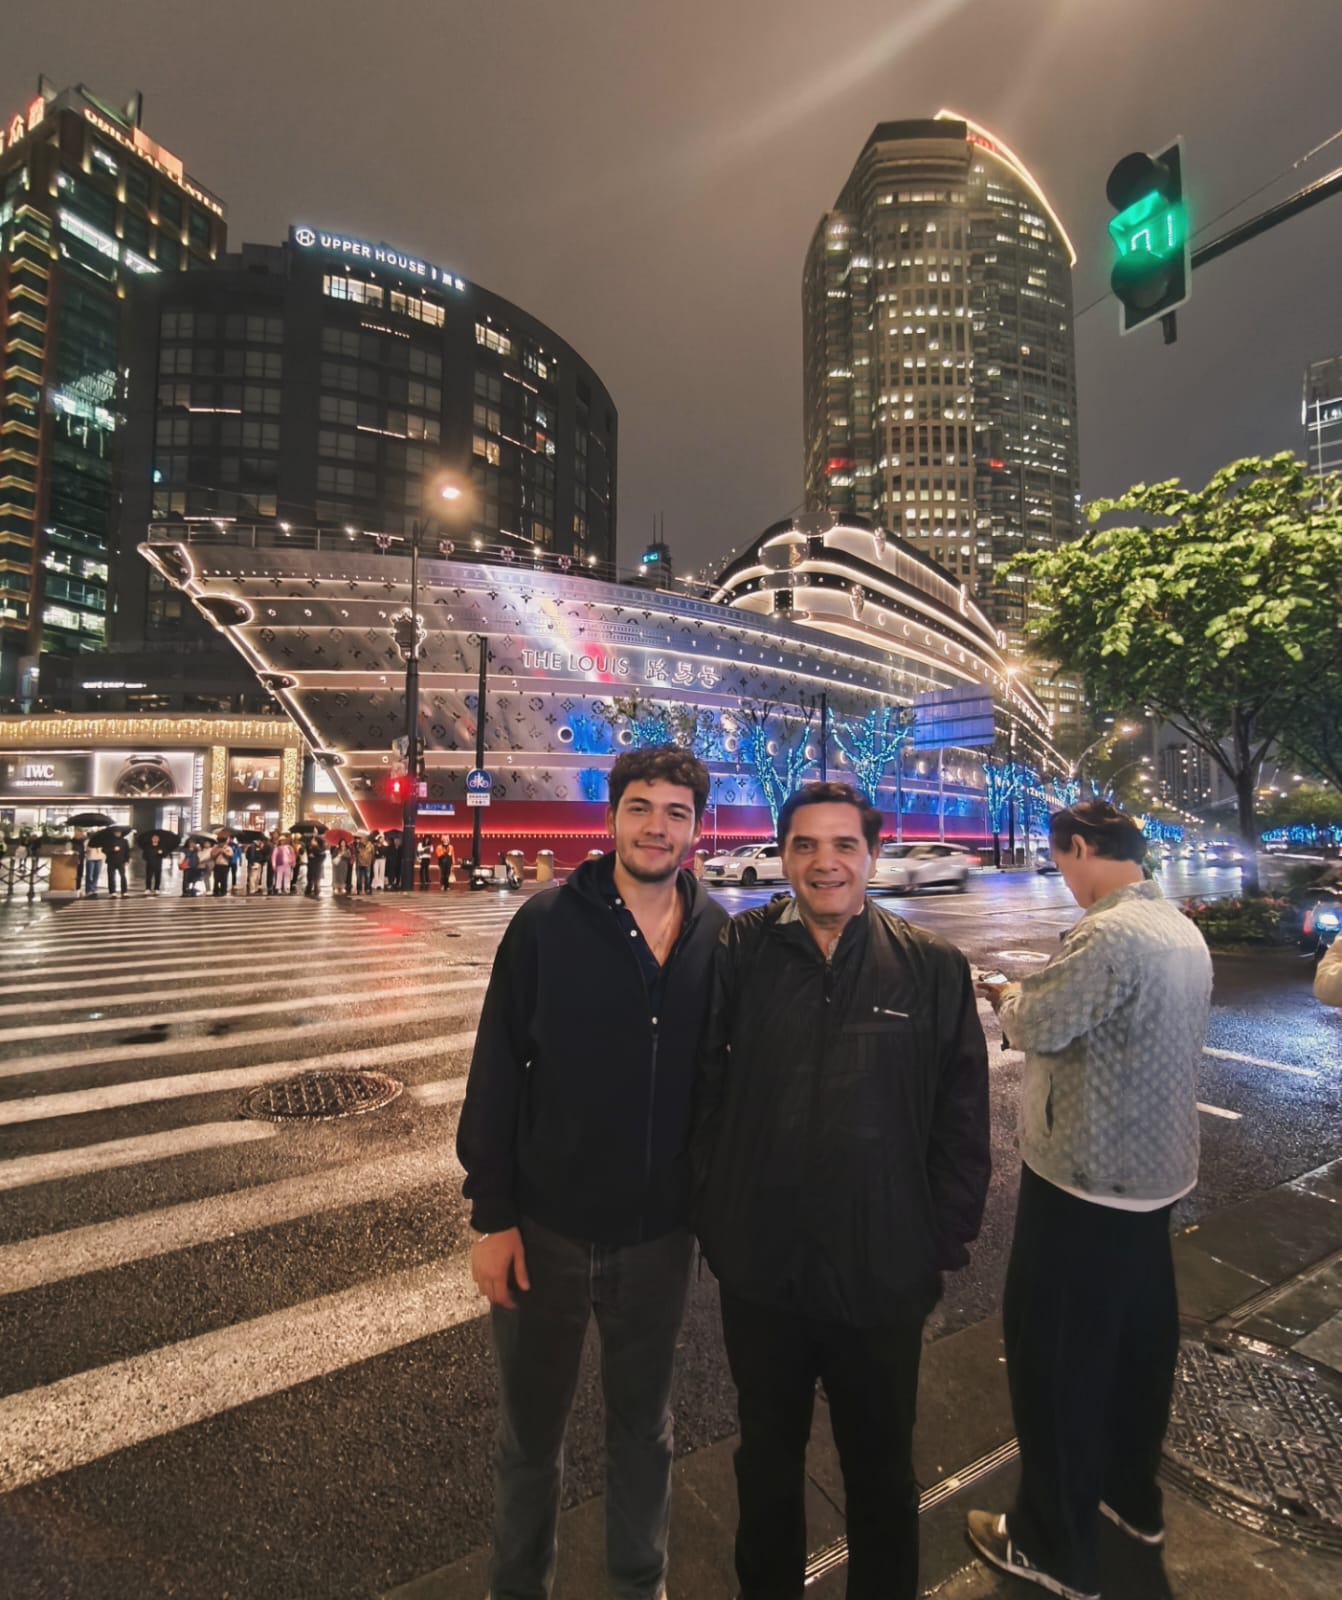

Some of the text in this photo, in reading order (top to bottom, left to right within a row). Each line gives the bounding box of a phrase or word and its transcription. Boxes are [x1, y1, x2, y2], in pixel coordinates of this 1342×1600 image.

[321, 236, 426, 276] UPPER HOUSE
[522, 649, 631, 677] THE LOUIS
[644, 657, 721, 689] 路易号
[24, 764, 55, 779] IWC
